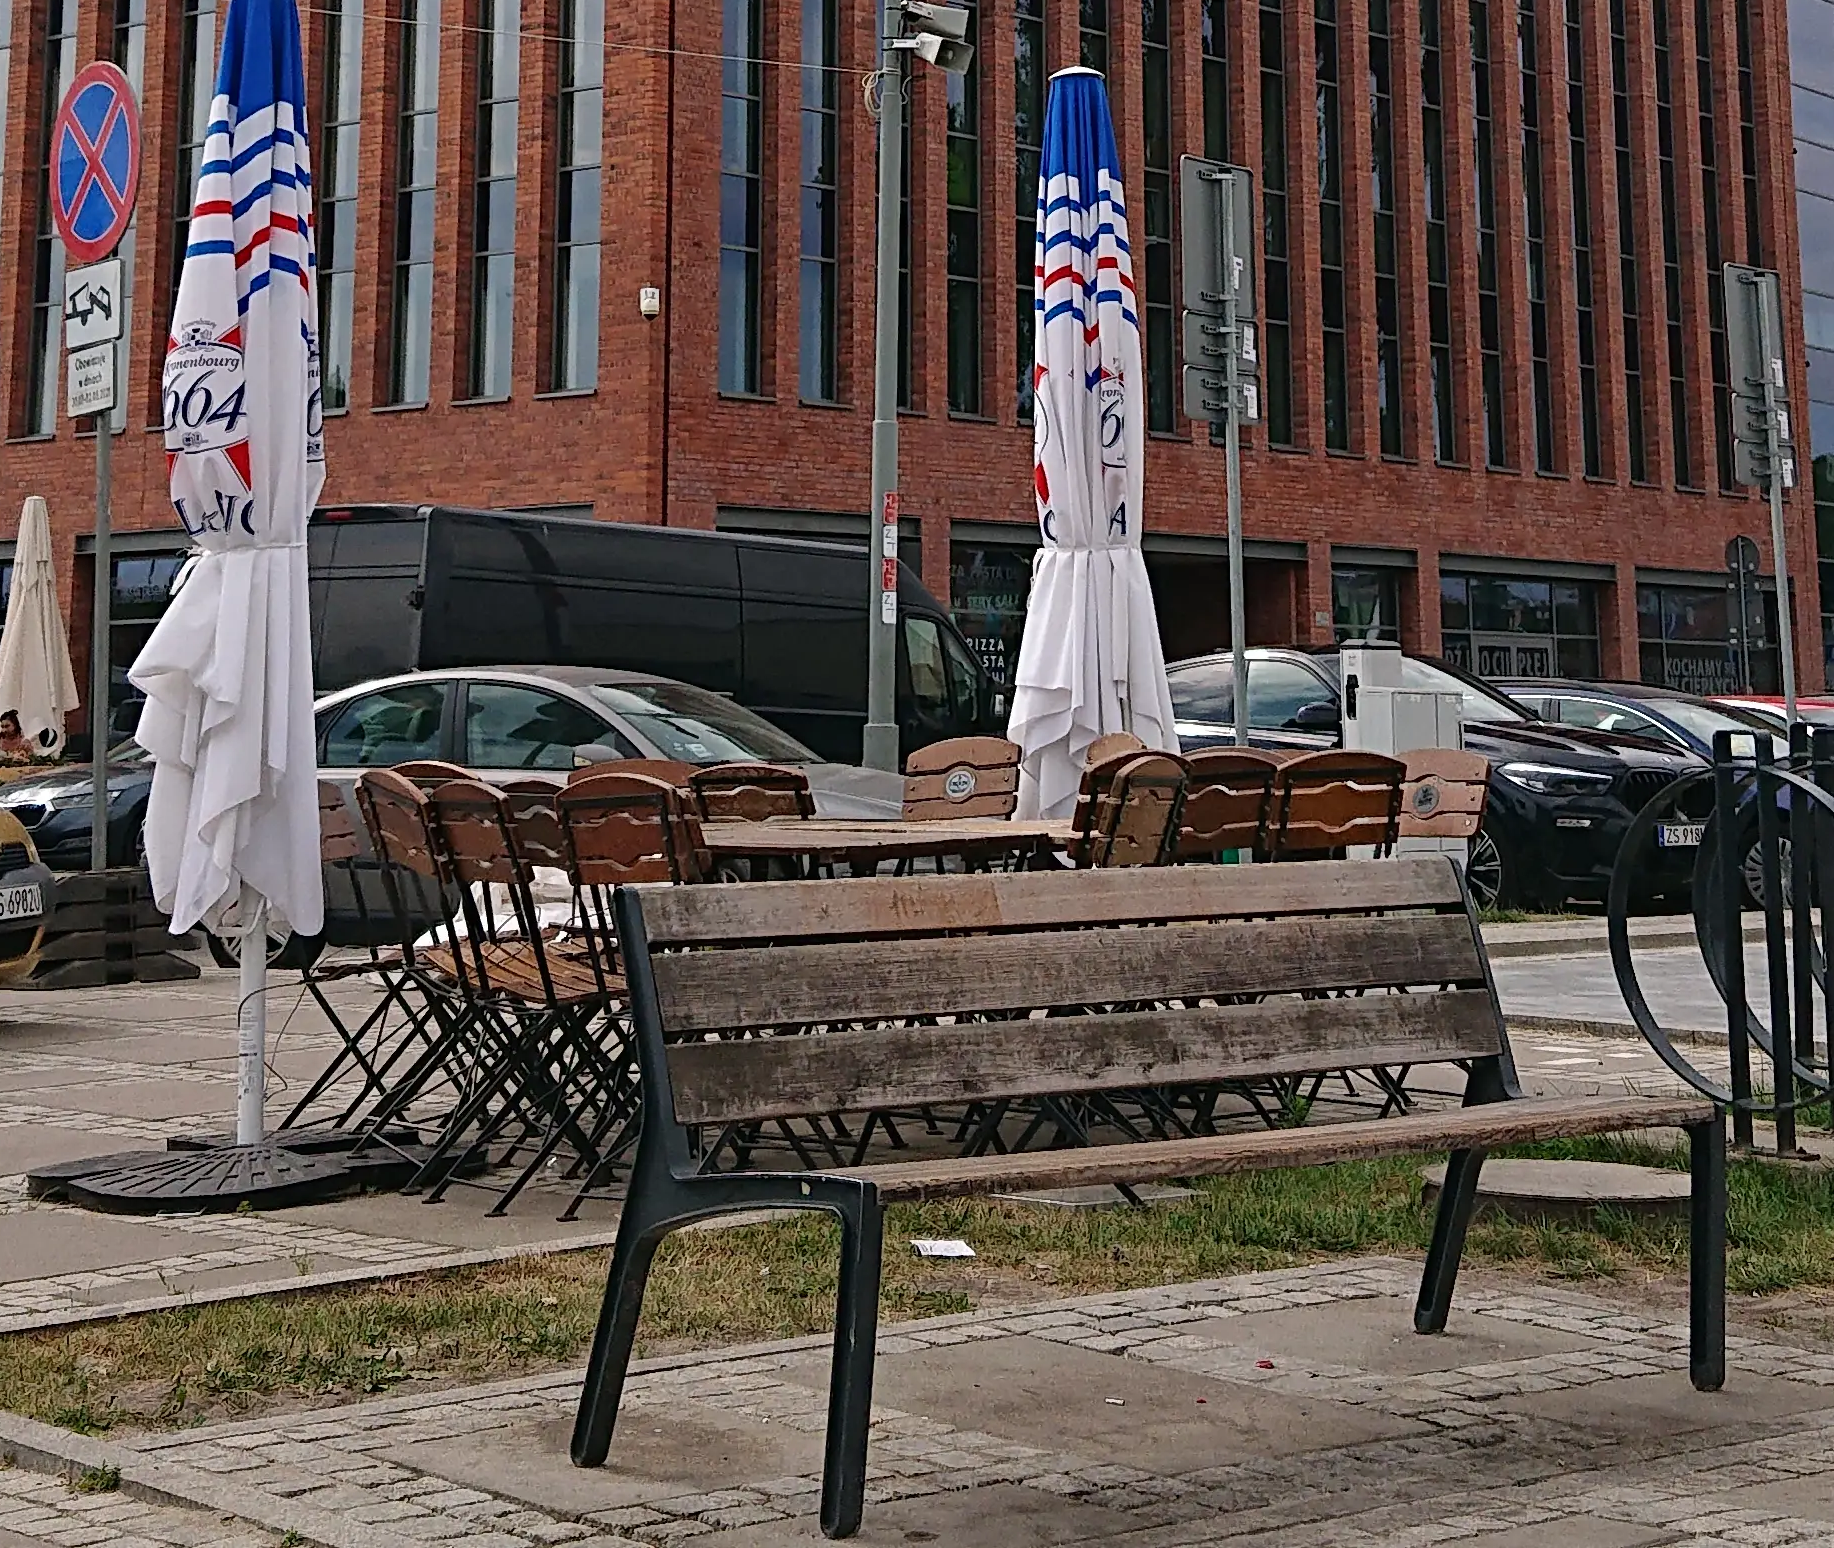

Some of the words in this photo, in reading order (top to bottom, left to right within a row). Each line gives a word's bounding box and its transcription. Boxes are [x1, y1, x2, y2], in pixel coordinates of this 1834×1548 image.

[1666, 657, 1722, 676] KOCHAMY
[1666, 828, 1679, 843] ZS
[8, 888, 41, 915] 6982U
